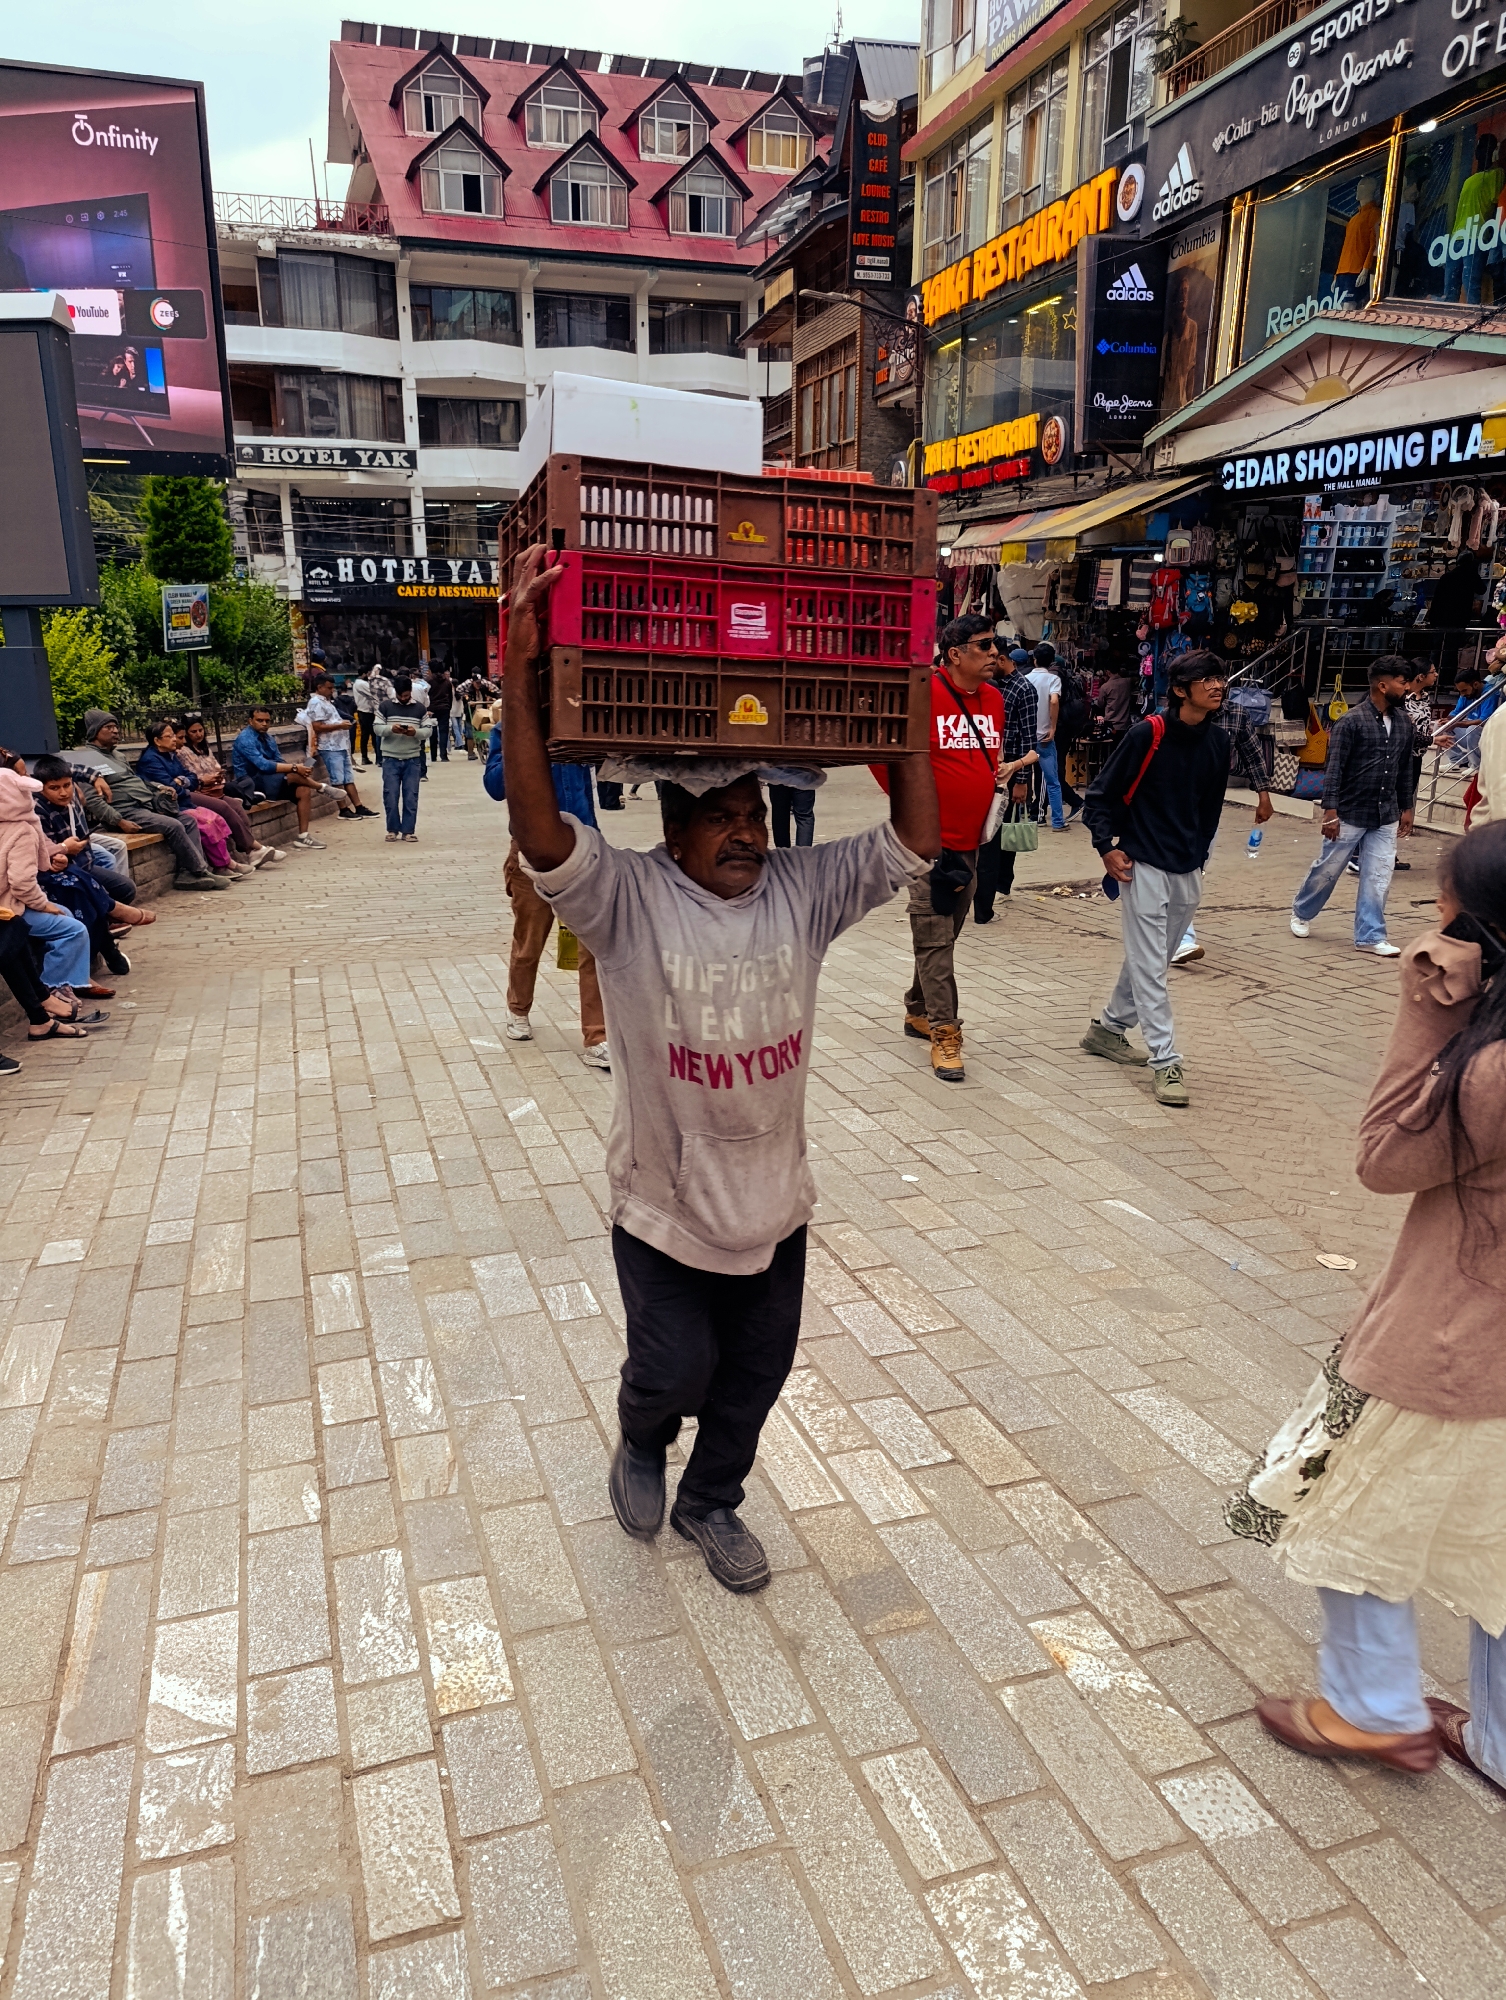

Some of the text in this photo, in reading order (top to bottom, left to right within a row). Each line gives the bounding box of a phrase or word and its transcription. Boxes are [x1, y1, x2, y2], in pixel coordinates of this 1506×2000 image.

[988, 0, 1007, 20] HO
[1309, 0, 1389, 55] SPORTS
[991, 30, 1016, 62] ROOMS
[1442, 21, 1491, 78] OF
[1284, 38, 1410, 129] Pepe Jeans
[1319, 111, 1368, 144] LONDON
[867, 132, 888, 147] CLUB
[868, 155, 888, 173] CAFÉ
[860, 183, 891, 199] LOUNGE
[1152, 182, 1201, 222] adidas
[113, 210, 128, 218] 2:45
[860, 209, 890, 224] RESTRO
[853, 232, 895, 248] LIVE MUSIC
[921, 166, 1120, 328] ZAIKA RESTAURANT
[1170, 225, 1216, 260] Columbia
[1106, 286, 1155, 302] adidas
[76, 305, 110, 319] YouTube
[1110, 341, 1157, 355] Columbia
[1093, 391, 1153, 414] Pepe Jeans
[956, 412, 1041, 470] RESTAURANT
[261, 447, 411, 468] HOTEL YAK
[1221, 422, 1505, 491] CEDAR SHOPPING PLA
[1323, 476, 1382, 491] THE MALL MANALI
[336, 557, 436, 584] HOTEL
[396, 585, 427, 598] CAFE
[427, 585, 438, 598] &
[936, 714, 1000, 738] KARL
[939, 737, 1001, 750] LAGERELD
[668, 1029, 804, 1090] NEW YORK
